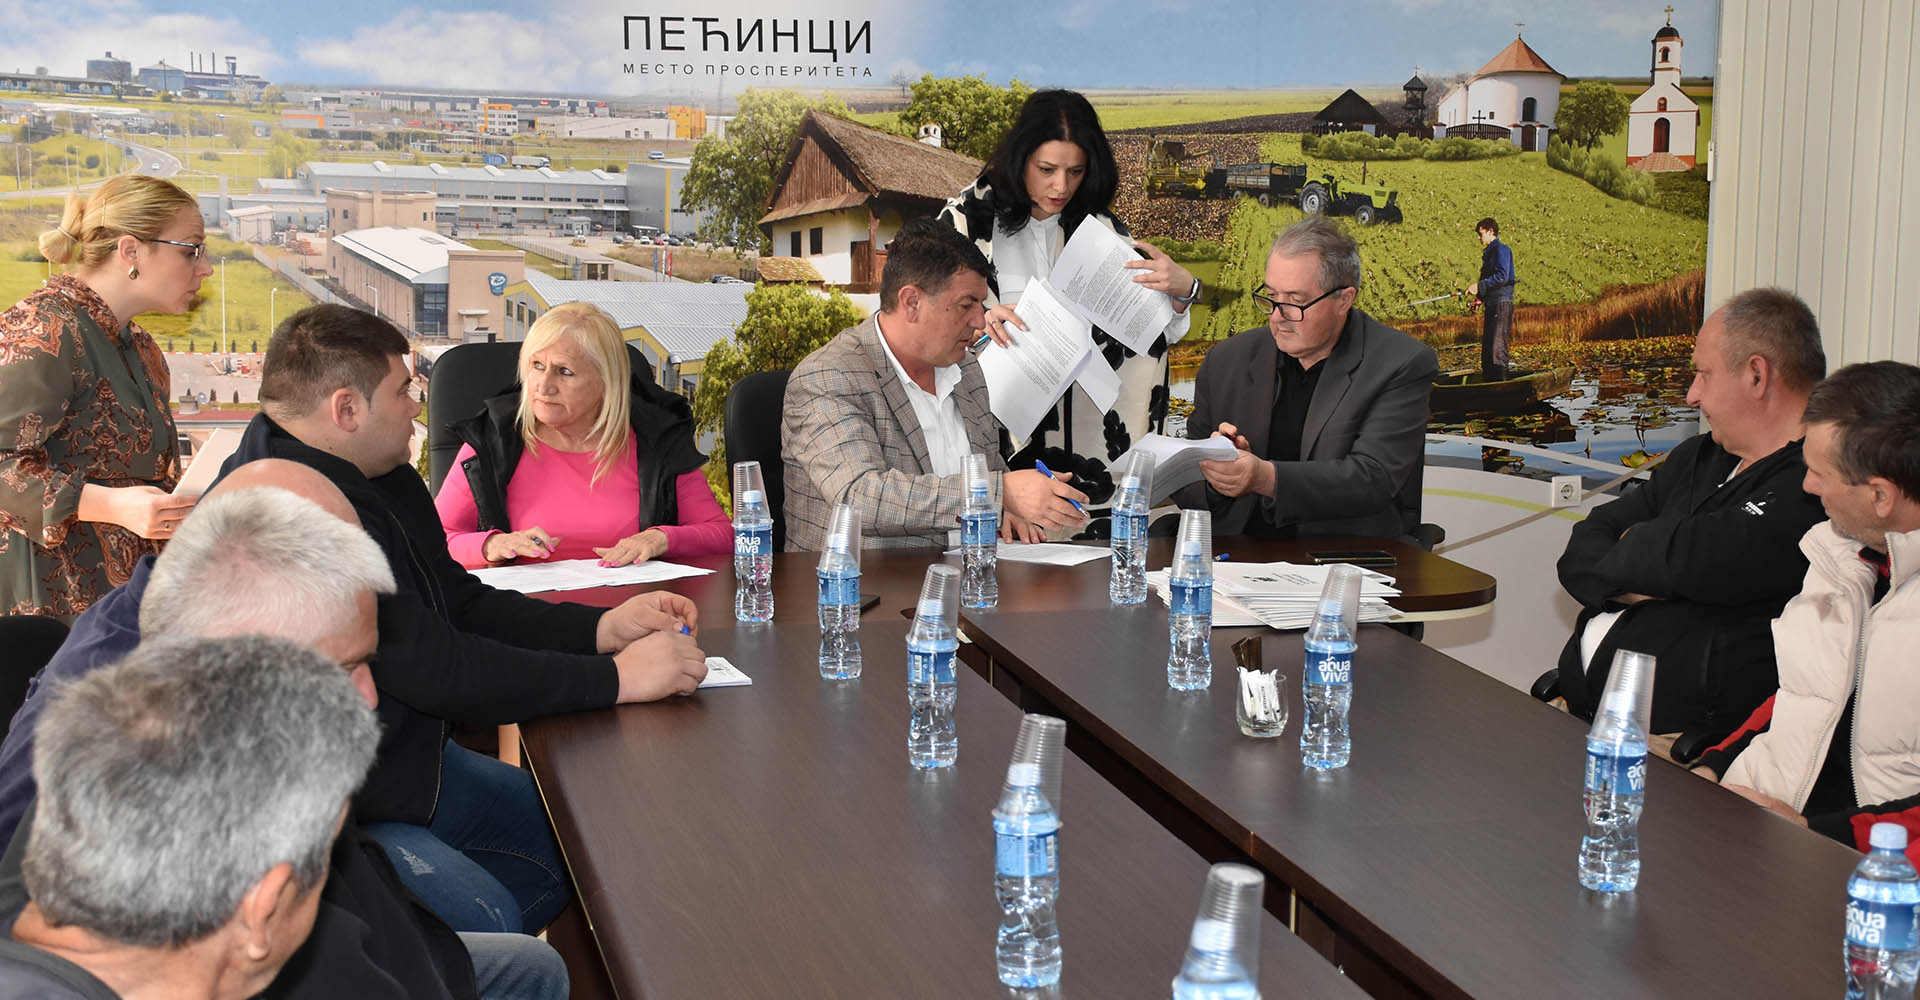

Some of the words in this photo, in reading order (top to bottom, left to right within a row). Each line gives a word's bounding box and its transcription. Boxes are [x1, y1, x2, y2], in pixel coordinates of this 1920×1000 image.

[623, 15, 872, 63] ПЕЋИНЦИ
[623, 63, 694, 76] МЕСТО
[705, 64, 872, 77] ПРОСПЕРИТЕТА
[737, 544, 759, 554] viva
[1320, 671, 1349, 683] viva
